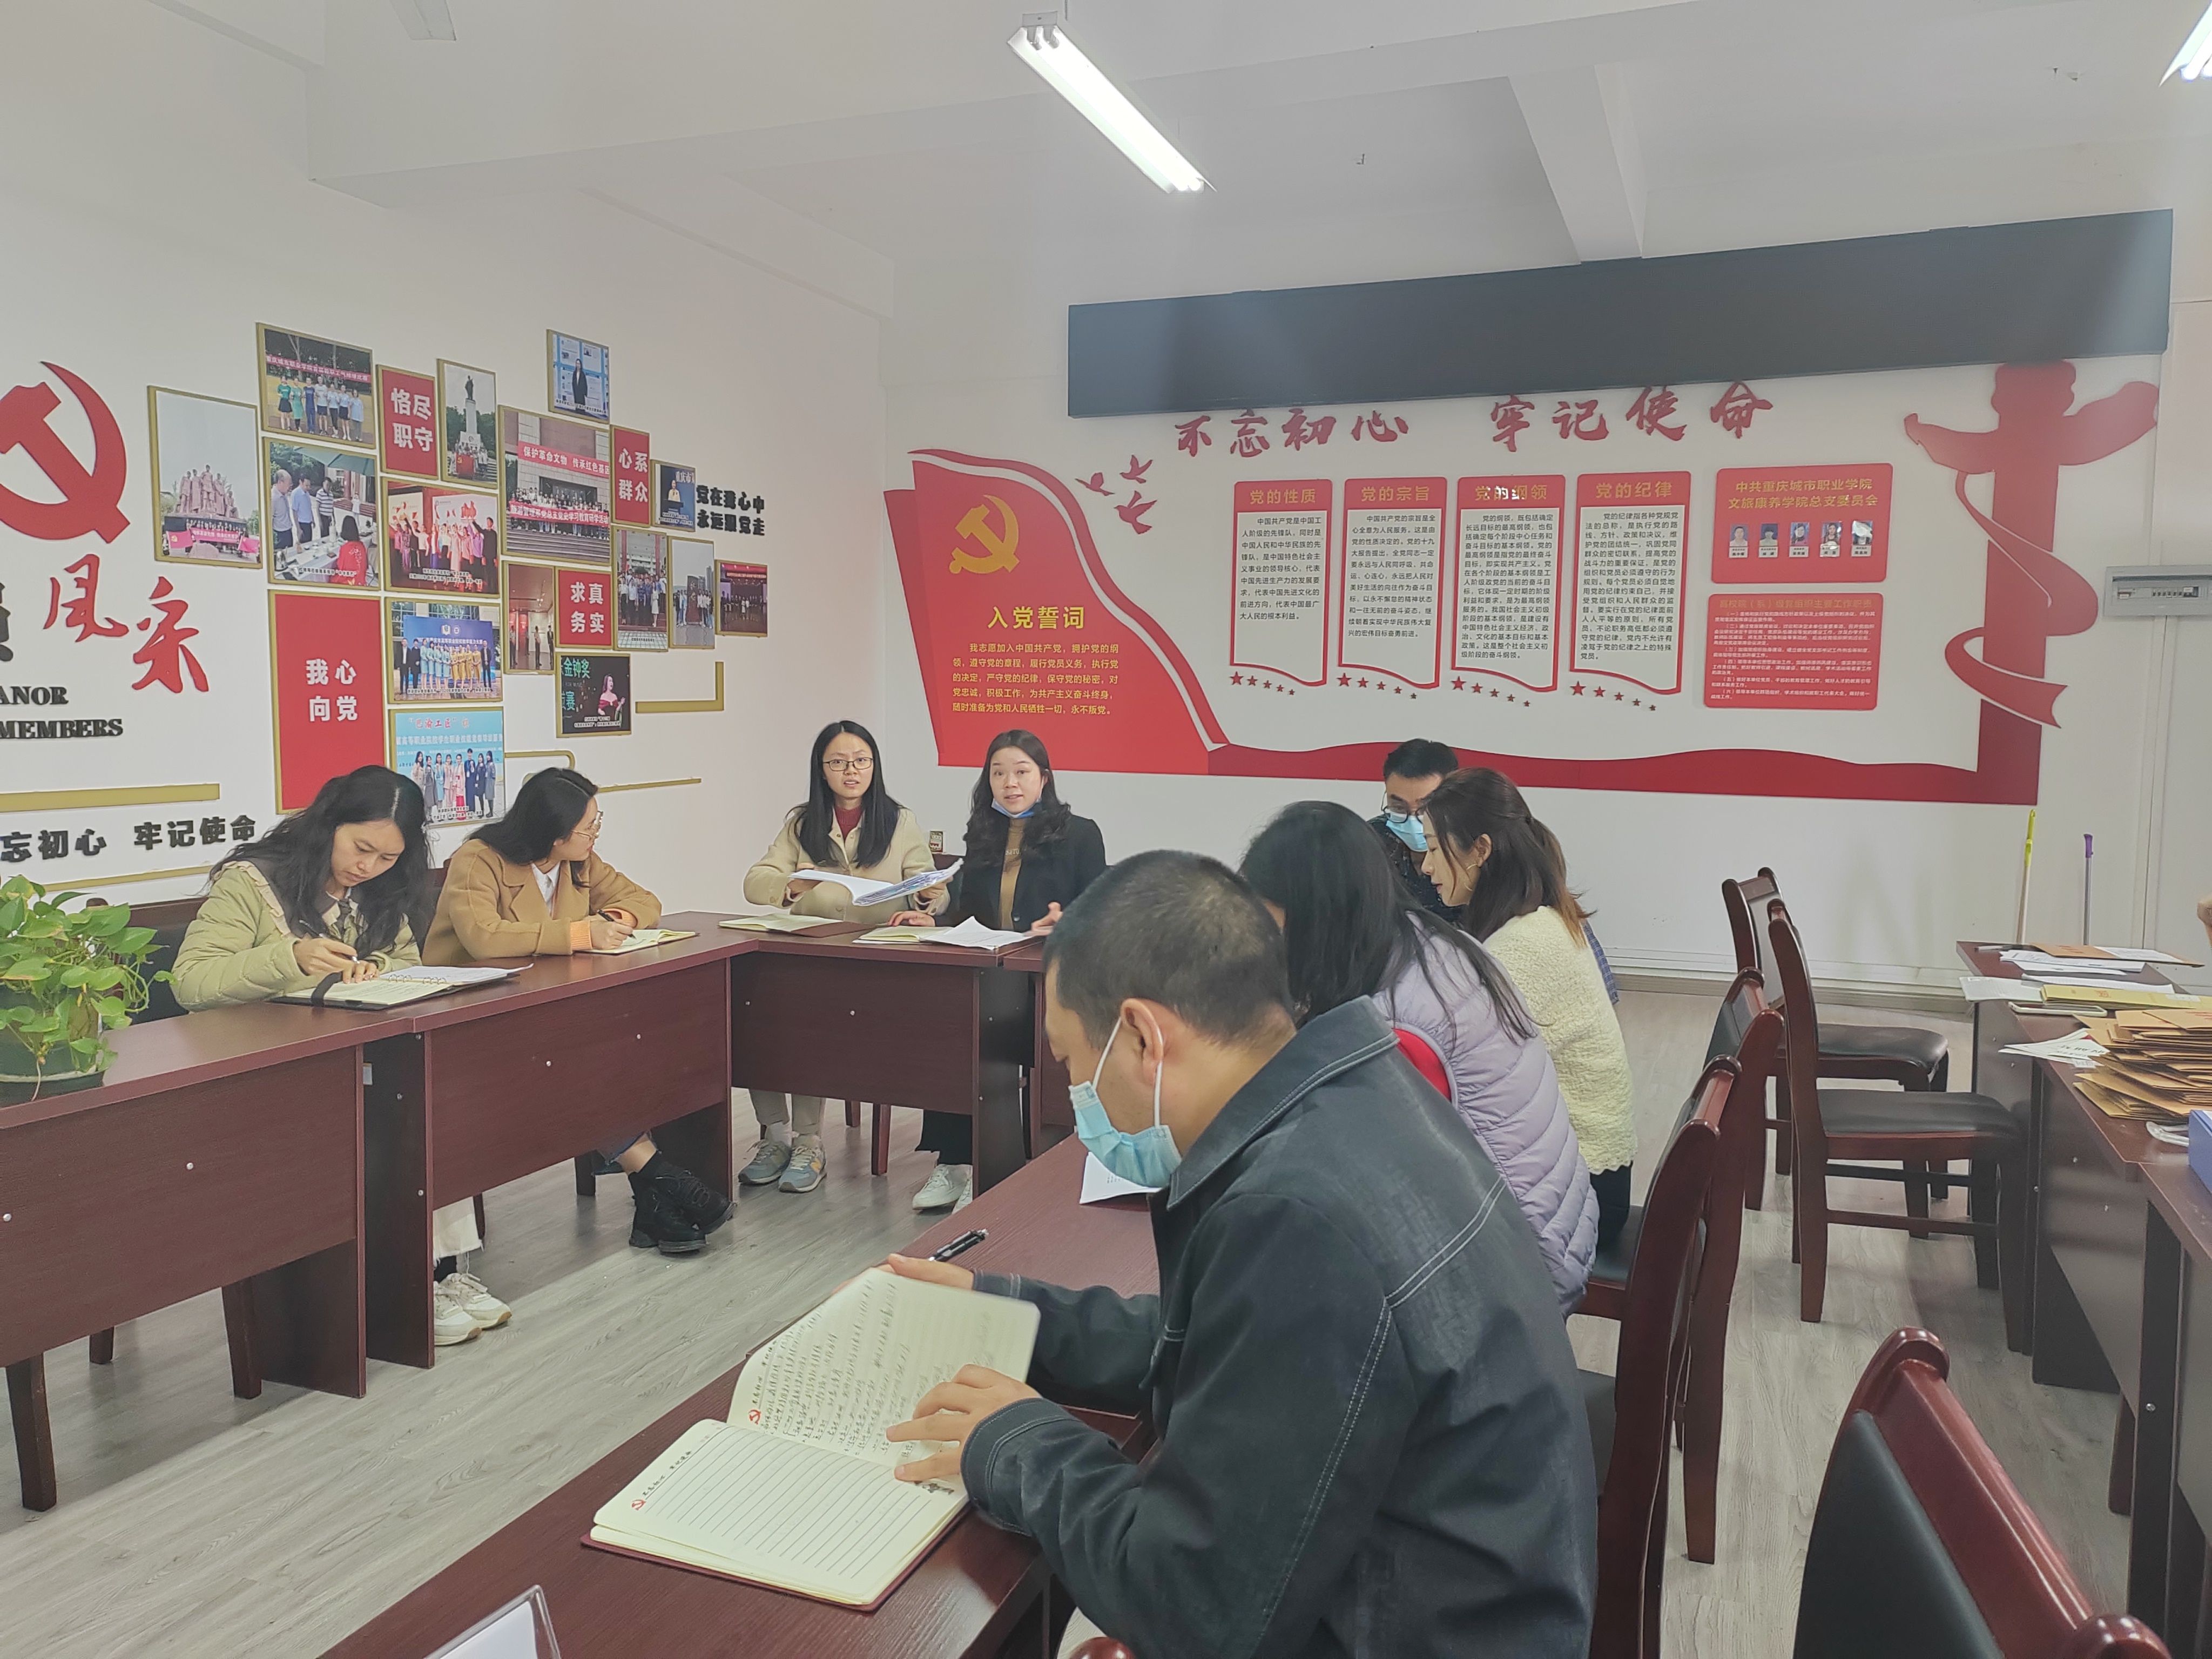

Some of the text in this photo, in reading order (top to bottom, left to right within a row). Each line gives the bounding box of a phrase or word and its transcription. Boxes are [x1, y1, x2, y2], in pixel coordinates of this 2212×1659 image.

[391, 387, 432, 421] 恪尽
[1175, 381, 1773, 457] 不忘初心 牢记使命
[393, 422, 433, 451] 职守
[524, 446, 610, 474] 保护革命文物 传承红色基因
[619, 448, 648, 474] 心系
[619, 478, 648, 503] 群众
[1250, 489, 1316, 504] 党的性质
[1361, 486, 1429, 502] 党的宗旨
[1475, 484, 1548, 501] 党的纲领
[1596, 481, 1673, 499] 党的纪律
[1736, 478, 1872, 493] 中共重庆城市职业学院
[696, 485, 764, 514] 党在我心中
[1729, 494, 1878, 509] 文旅康养学院总支委员会
[697, 509, 765, 535] 永远跟党走
[570, 582, 604, 605] 求真
[571, 611, 604, 634] 务实
[987, 606, 1084, 629] 入党誓词
[306, 659, 356, 685] 我心
[309, 696, 358, 721] 向党
[0, 719, 124, 738] MEMBERS
[0, 815, 255, 862] 忘初心 牢记使命
